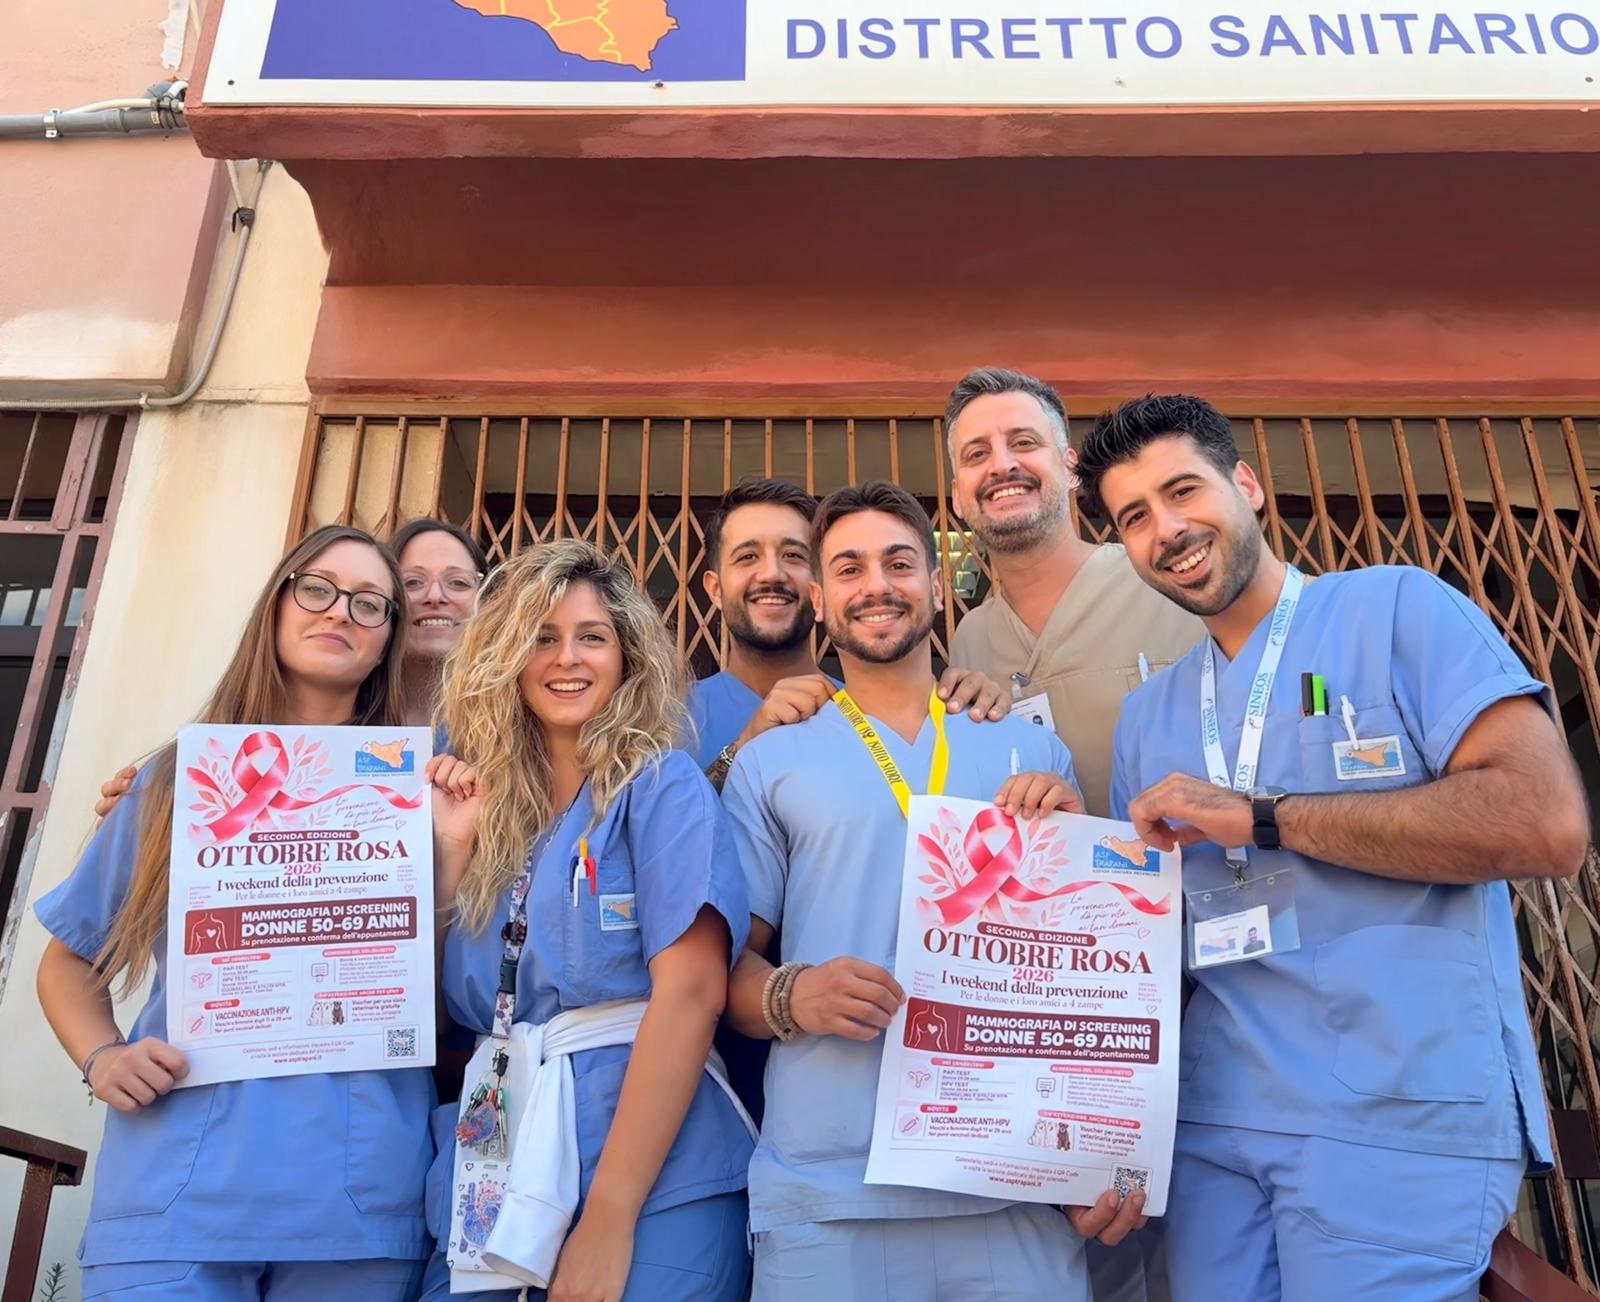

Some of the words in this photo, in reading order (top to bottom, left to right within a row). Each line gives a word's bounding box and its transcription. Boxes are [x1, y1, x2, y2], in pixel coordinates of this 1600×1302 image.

[786, 16, 1183, 59] DISTRETTO
[1209, 12, 1600, 58] SANITARIO
[1270, 597, 1291, 637] SINEOS
[1248, 671, 1269, 717] SINEOS
[257, 833, 304, 842] SECONDA
[306, 831, 352, 840] EDIZIONE
[197, 842, 330, 868] OTTOBRE
[336, 839, 409, 861] ROSA
[284, 863, 322, 876] 2026
[224, 876, 279, 891] weekend
[282, 875, 312, 888] della
[314, 872, 389, 888] prevenzione
[235, 892, 248, 901] Per
[250, 890, 257, 899] le
[257, 889, 281, 899] donne
[293, 889, 308, 897] loro
[309, 887, 329, 896] amici
[343, 886, 367, 896] zampe
[241, 906, 331, 922] MAMMOGRAFIA
[332, 905, 344, 915] DI
[346, 902, 410, 915] SCREENING
[241, 919, 307, 938] DONNE
[366, 913, 409, 929] ANNI
[985, 925, 1036, 940] SECONDA
[1038, 933, 1088, 944] EDIZIONE
[240, 938, 251, 946] Su
[251, 936, 300, 947] prenotazione
[307, 934, 341, 942] conferma
[342, 930, 409, 940] dell'appuntamento
[923, 927, 1063, 970] OTTOBRE
[1070, 948, 1152, 974] ROSA
[1012, 967, 1054, 983] 2026
[950, 976, 1008, 993] weekend
[1011, 980, 1043, 995] della
[1045, 985, 1128, 999] prevenzione
[960, 990, 974, 1000] Per
[975, 991, 983, 1000] le
[983, 992, 1009, 1004] donne
[1021, 996, 1038, 1005] loro
[1038, 999, 1061, 1008] amici
[1068, 999, 1075, 1008] 4
[1077, 1000, 1104, 1011] zampe
[215, 1009, 261, 1020] VACCINAZIONE
[261, 1006, 291, 1016] ANTI-HPV
[965, 1014, 1062, 1031] MAMMOGRAFIA
[1064, 1020, 1077, 1031] DI
[1079, 1022, 1152, 1035] SCREENING
[964, 1027, 1036, 1045] DONNE
[1100, 1034, 1151, 1050] ANNI
[963, 1043, 974, 1052] Su
[975, 1044, 1027, 1056] prenotazione
[1034, 1047, 1072, 1056] conferma
[1073, 1048, 1150, 1060] dell'appuntamento
[930, 1116, 978, 1125] VACCINAZIONE
[978, 1118, 1010, 1127] ANTI-HPV
[1080, 1126, 1104, 1134] Voucher
[1080, 1134, 1111, 1142] veterinaria
[1112, 1136, 1135, 1146] gratuita
[989, 1176, 1042, 1188] www.asptrapani.it
